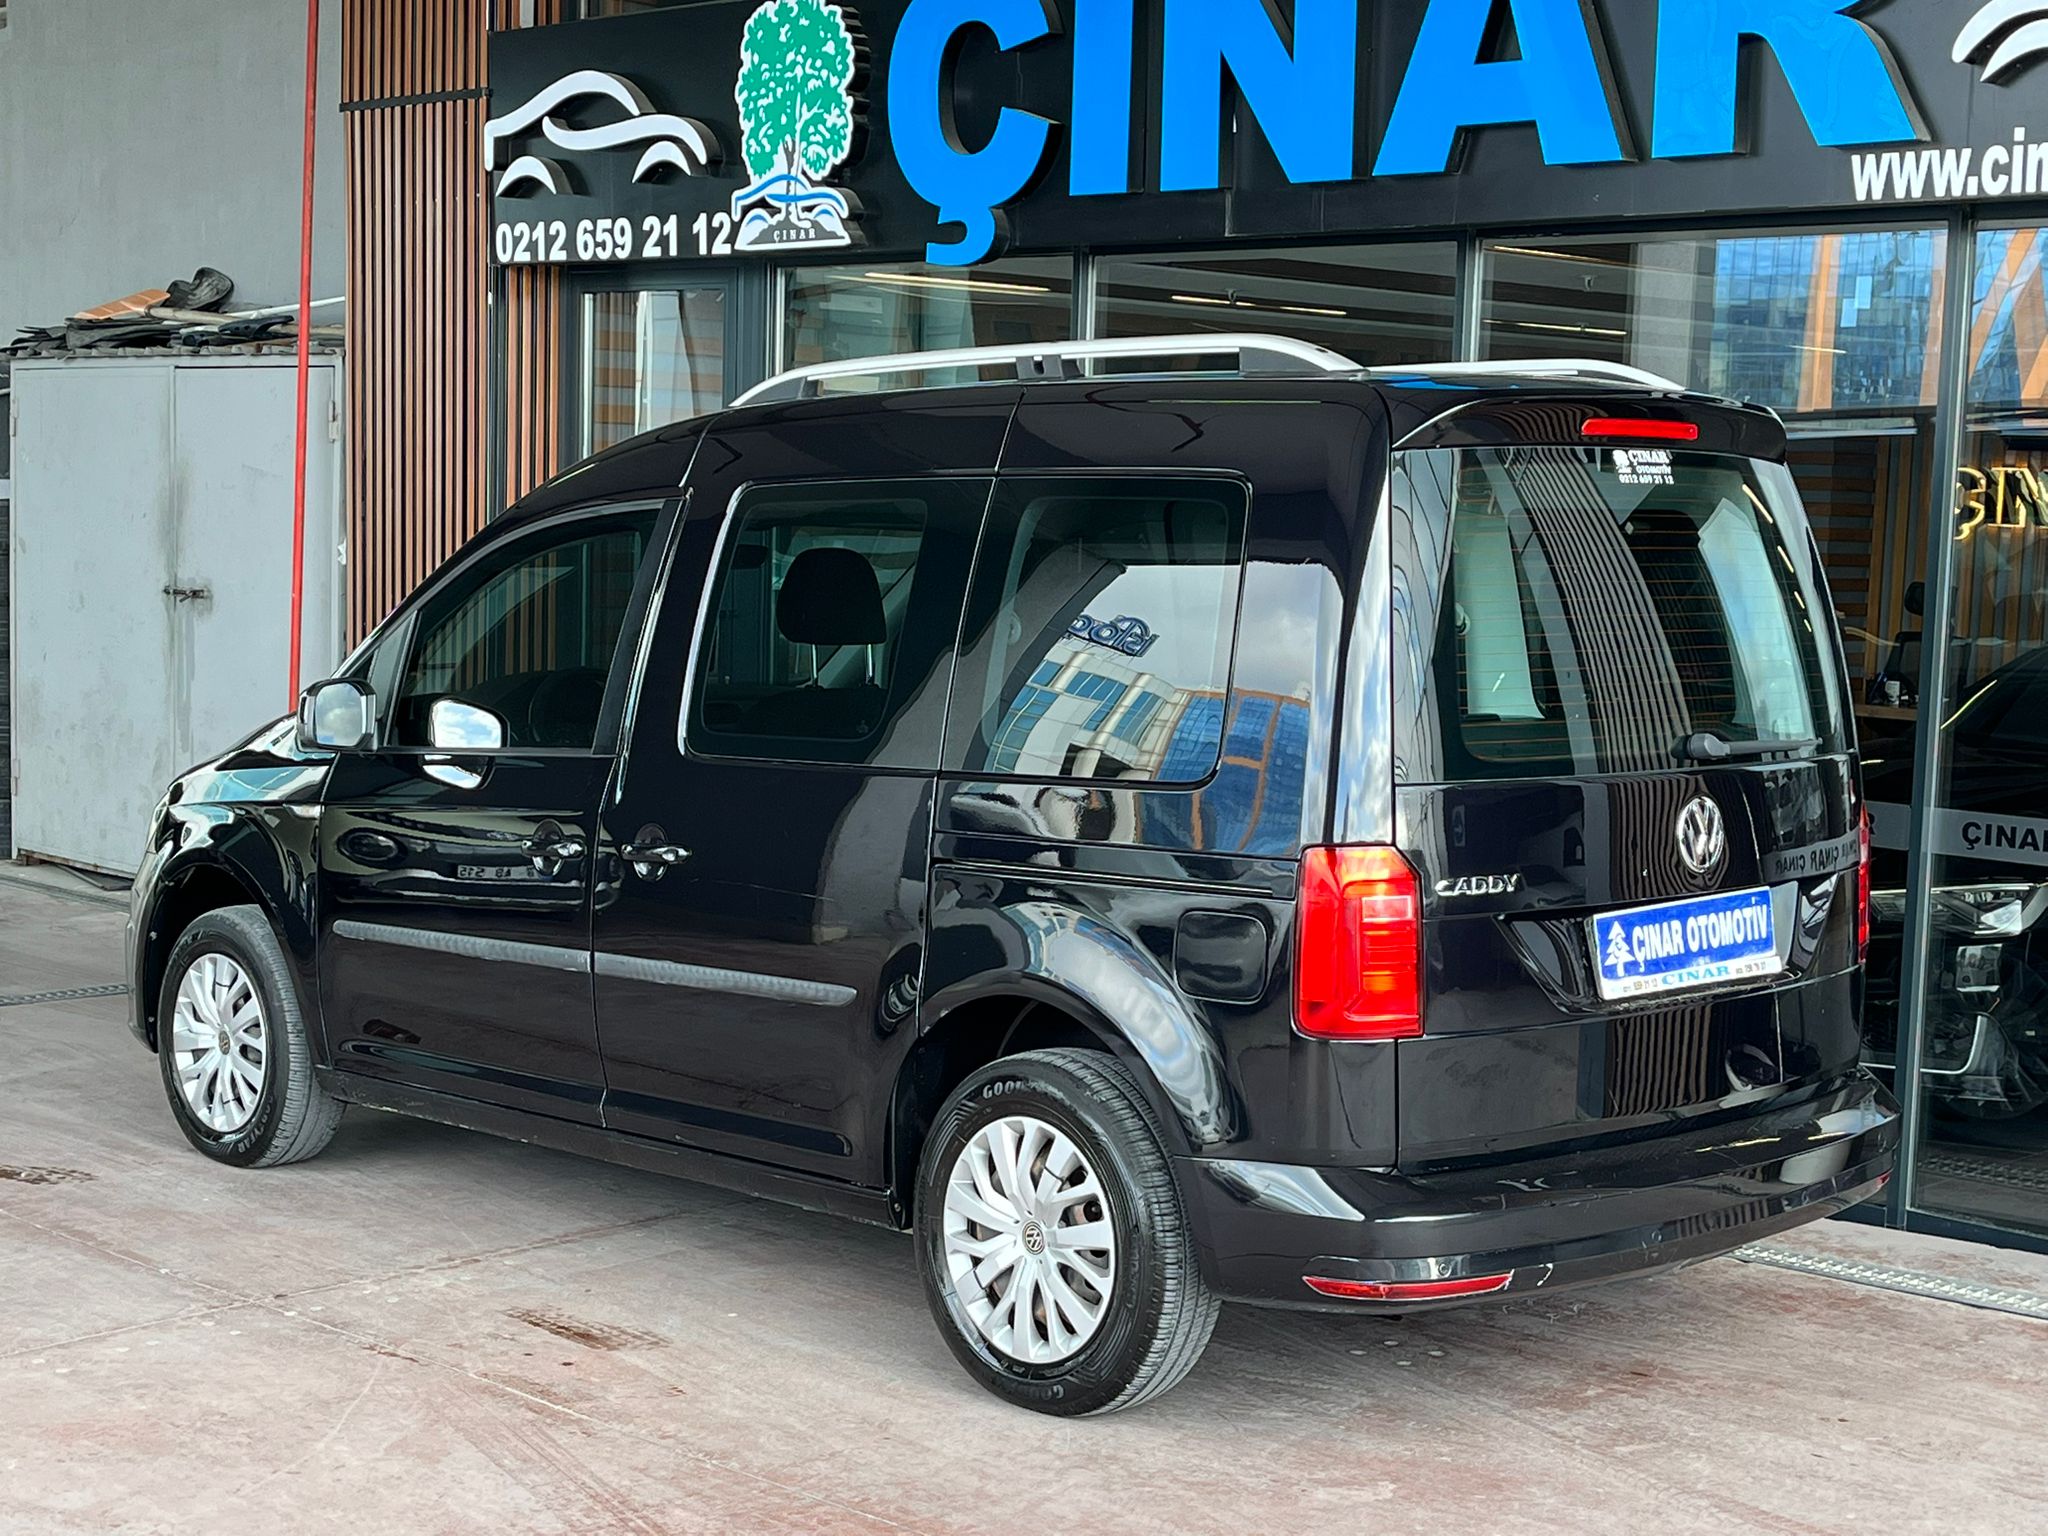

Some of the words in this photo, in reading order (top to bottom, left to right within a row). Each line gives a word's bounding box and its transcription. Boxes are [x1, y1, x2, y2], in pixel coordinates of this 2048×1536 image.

[495, 221, 567, 263] 0212
[576, 217, 633, 260] 659
[642, 214, 678, 257] 21
[692, 212, 732, 255] 12
[773, 228, 816, 244] ÇINAR
[1961, 821, 2048, 852] ÇINA
[1435, 873, 1522, 896] CADDY
[1632, 919, 1685, 973] ÇINAR
[1686, 897, 1768, 953] OTOMOTİV
